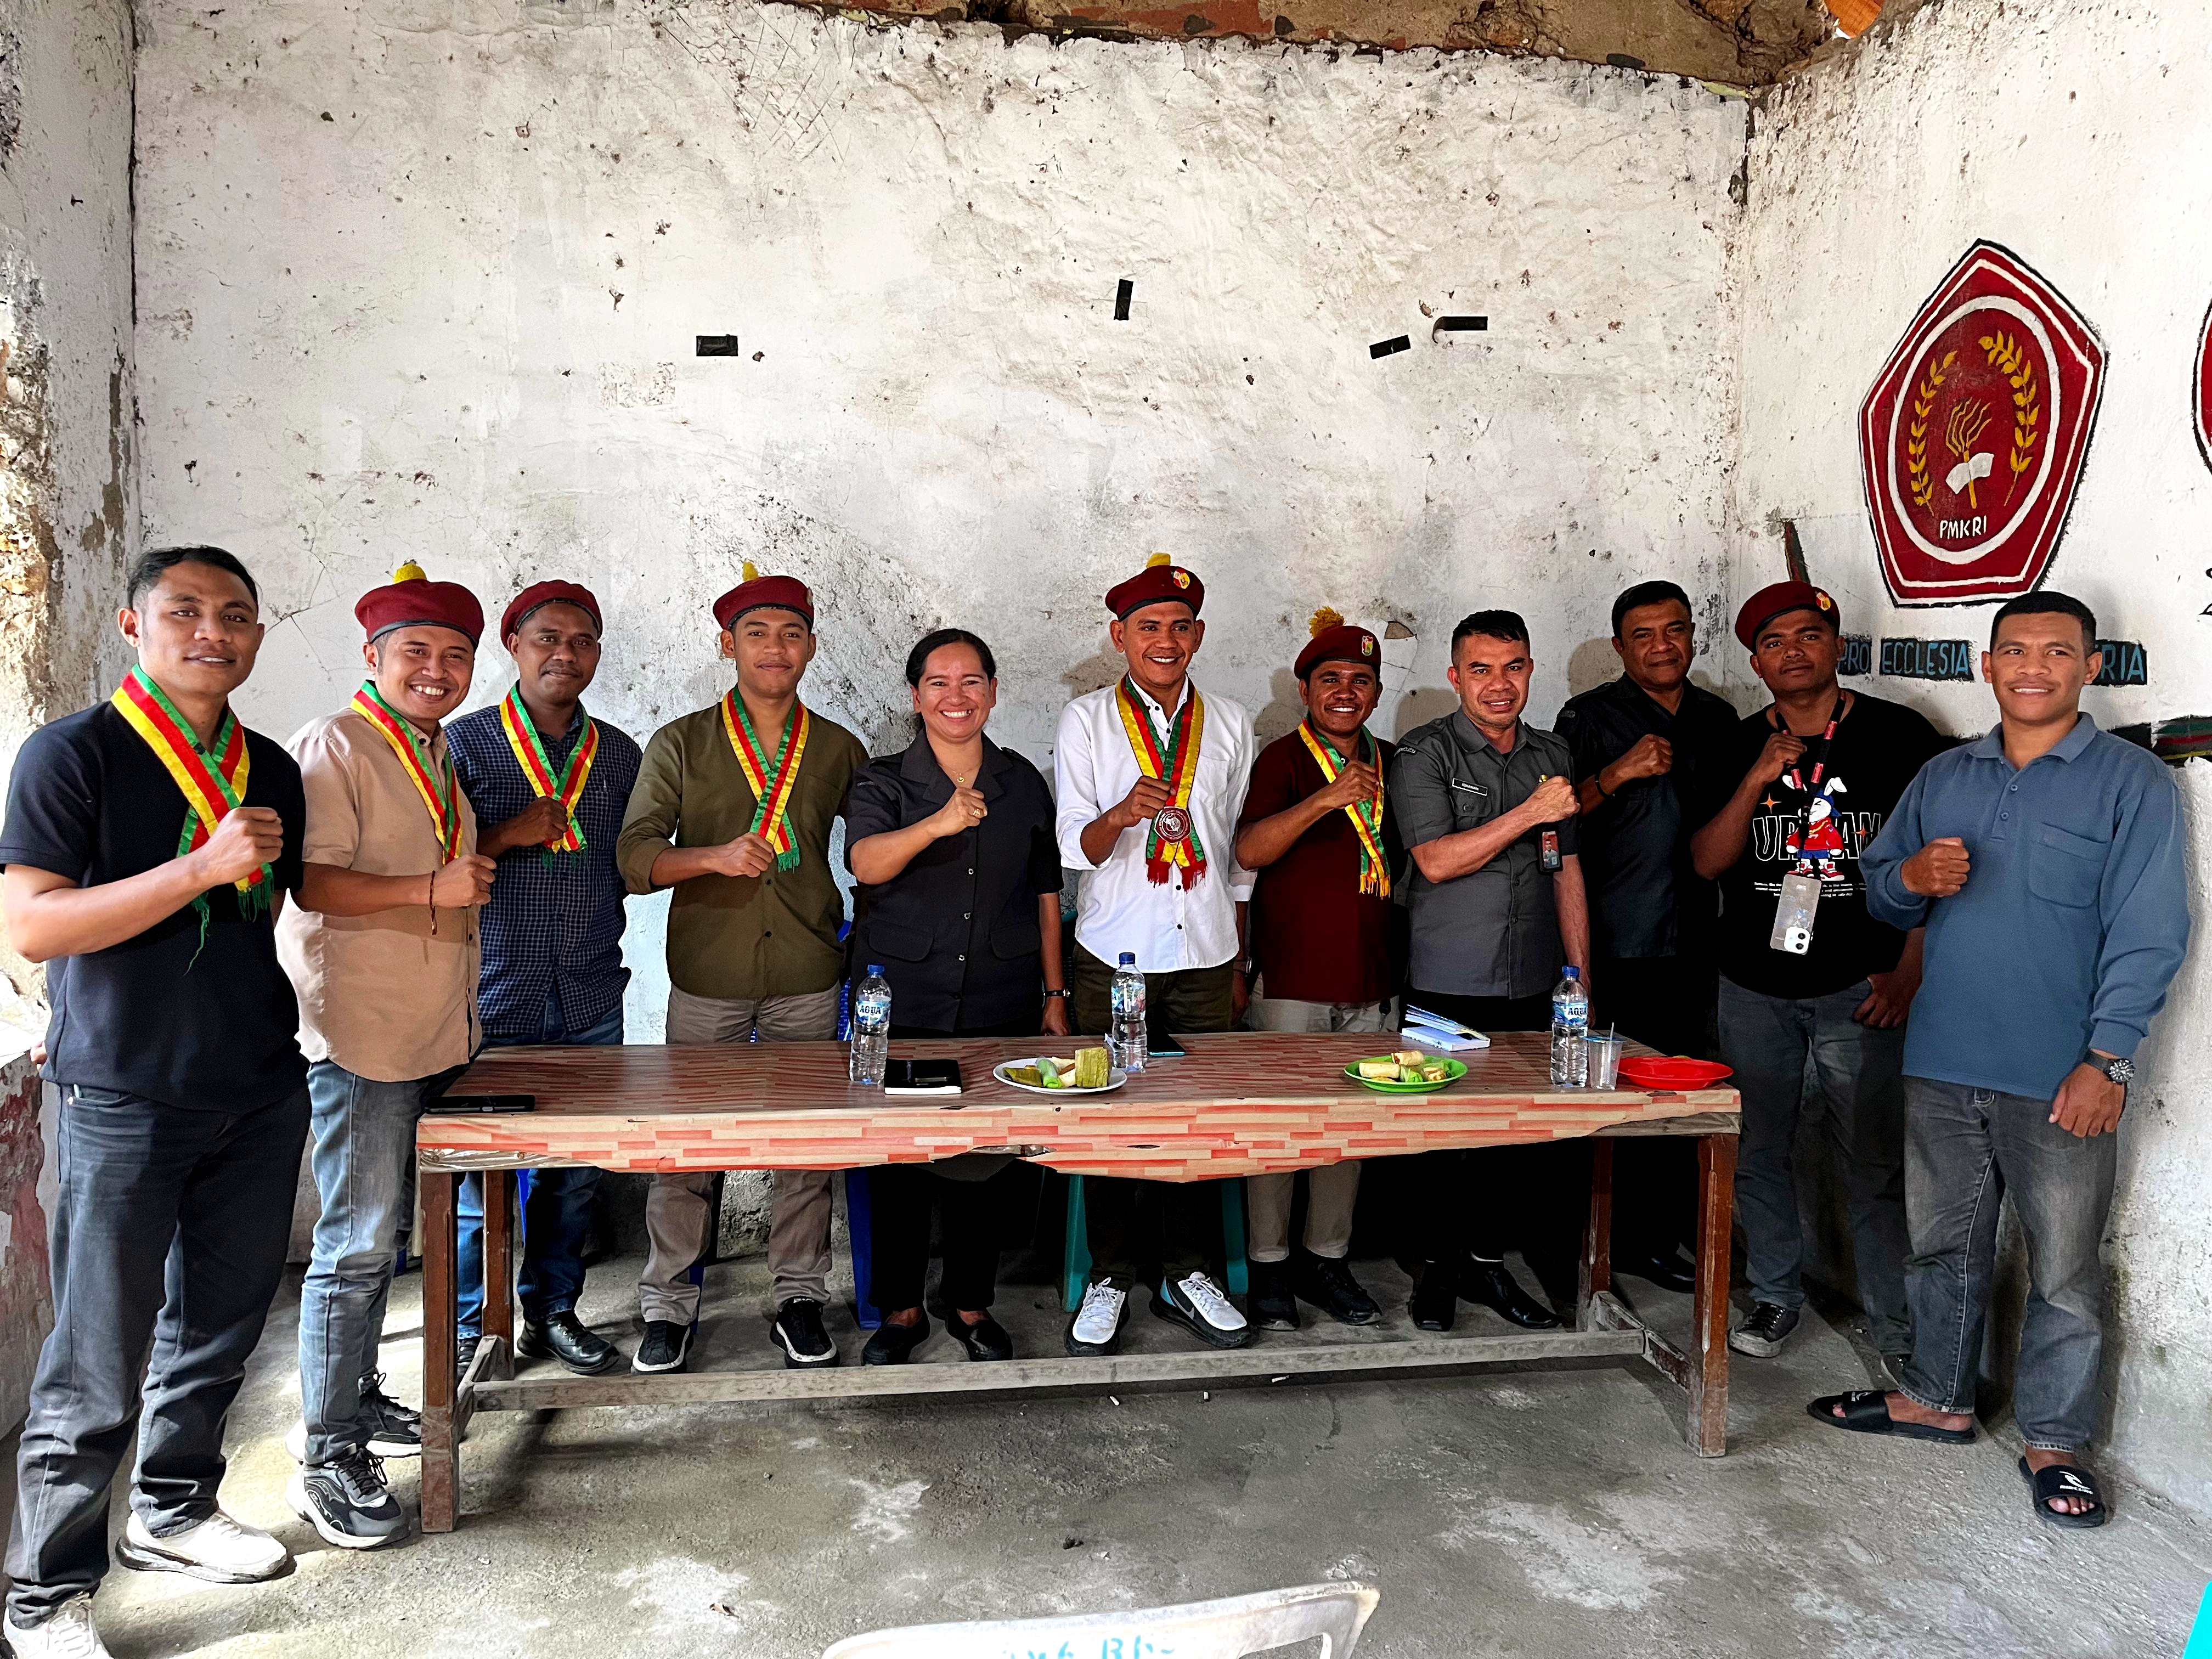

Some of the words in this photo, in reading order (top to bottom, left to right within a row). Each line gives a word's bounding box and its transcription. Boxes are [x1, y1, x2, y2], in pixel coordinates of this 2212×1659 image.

[1939, 515, 1987, 540] PMKRI
[1882, 641, 1969, 676] ECCLESIA
[2095, 644, 2145, 681] RIA
[1753, 812, 1881, 861] URAN
